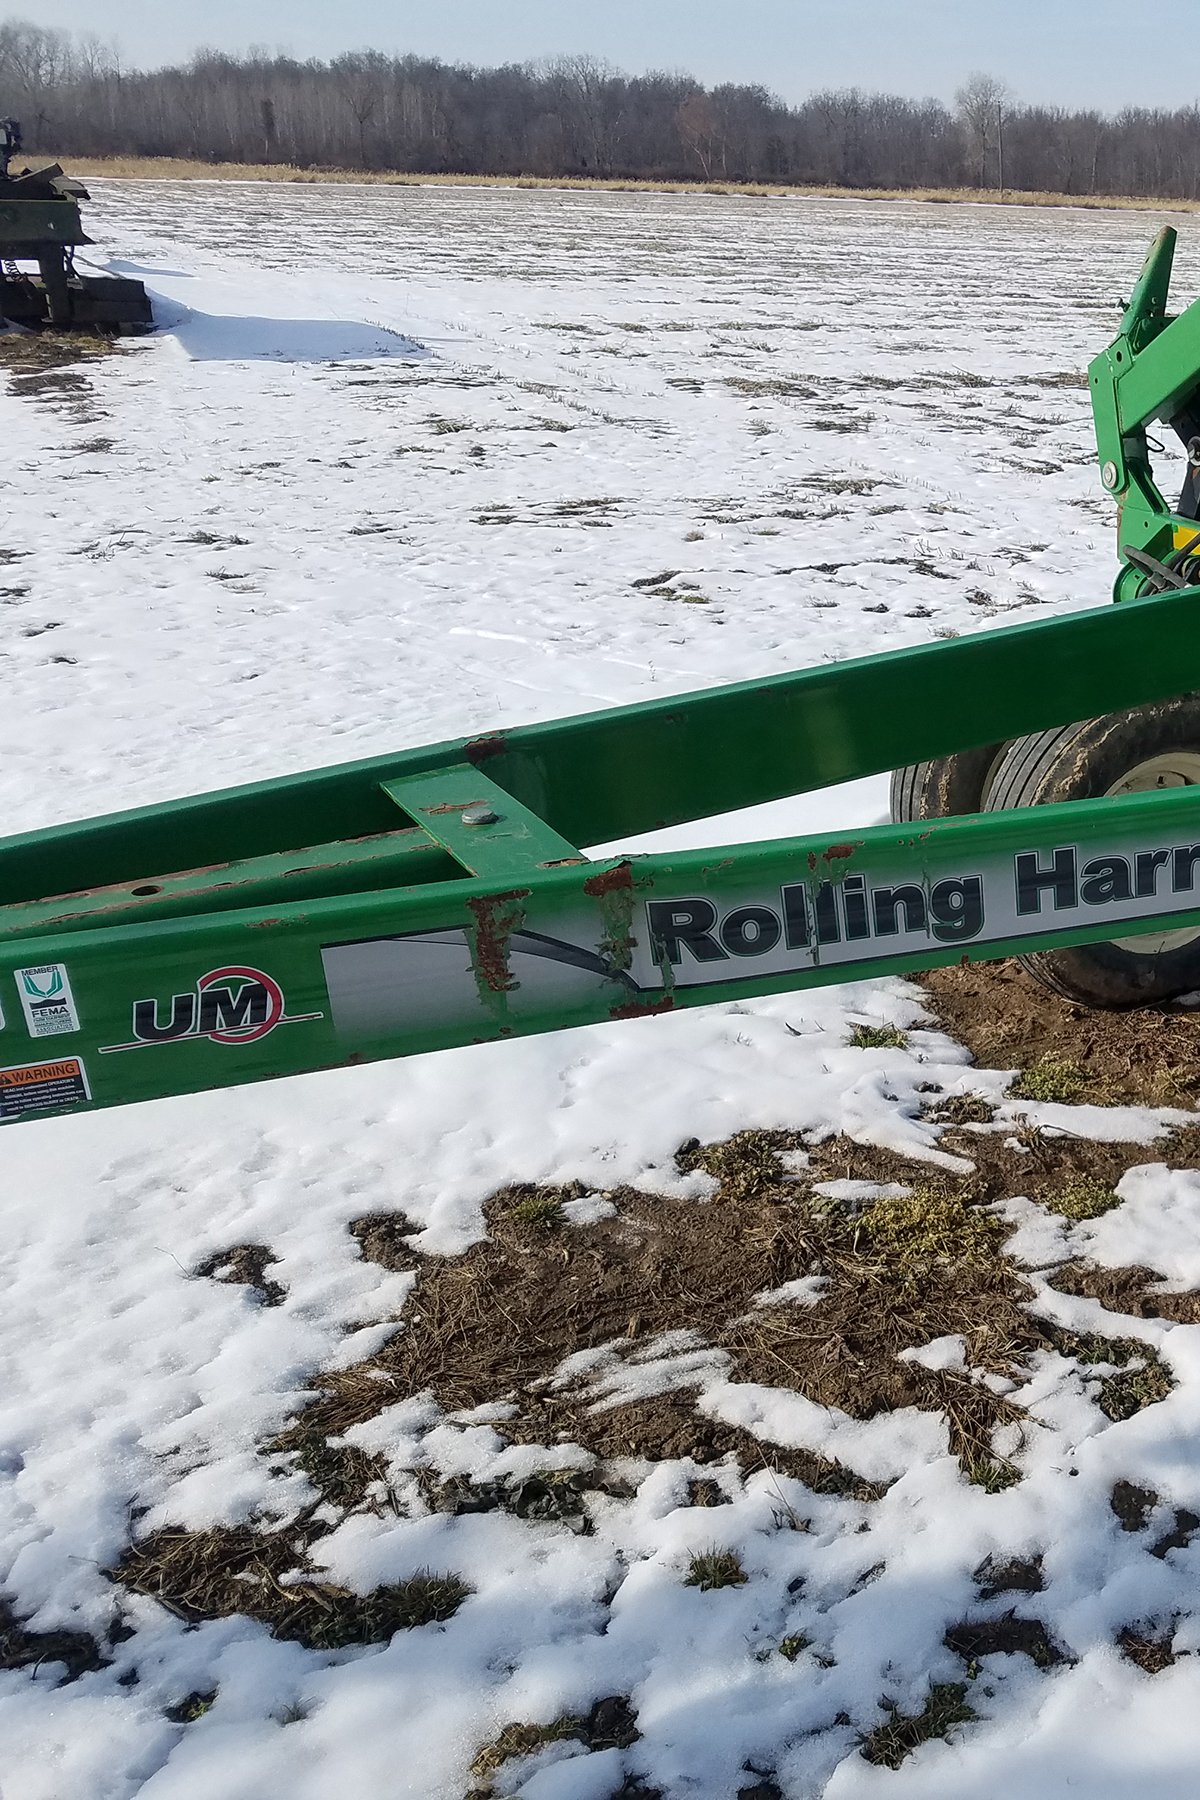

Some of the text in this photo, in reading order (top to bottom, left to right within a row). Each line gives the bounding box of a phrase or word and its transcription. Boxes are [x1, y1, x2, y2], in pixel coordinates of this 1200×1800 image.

[645, 873, 984, 967] Rolling
[21, 966, 58, 976] MEMBER
[31, 1006, 69, 1018] FEMA
[133, 982, 269, 1040] UM
[12, 1063, 75, 1081] WARNING
